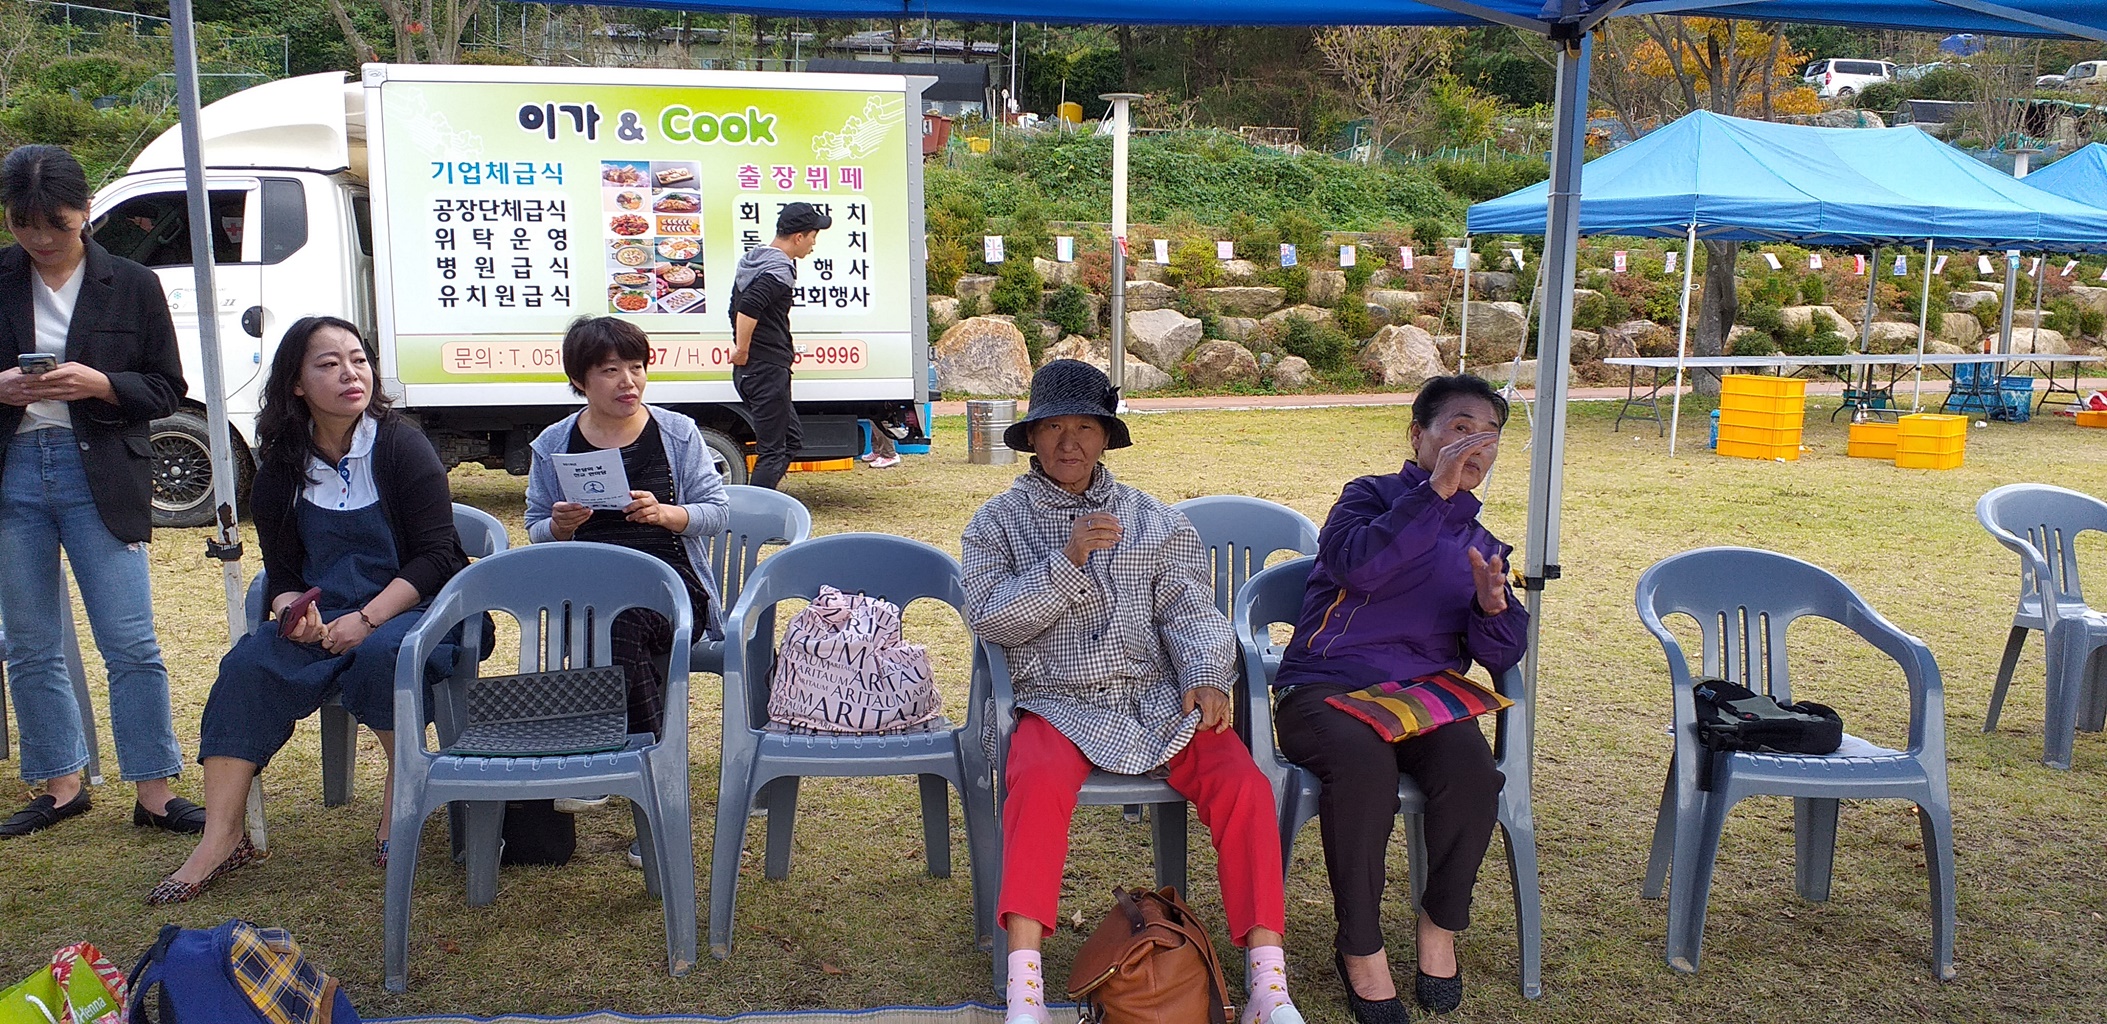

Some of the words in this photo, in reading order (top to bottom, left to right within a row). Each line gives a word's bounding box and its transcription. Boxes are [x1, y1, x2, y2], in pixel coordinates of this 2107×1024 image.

[518, 103, 600, 141] 이가
[617, 112, 645, 141] &
[661, 107, 775, 142] Cook
[431, 161, 563, 185] 기업체급식
[432, 199, 566, 223] 공장단체급식
[437, 285, 571, 308] 유치원급식
